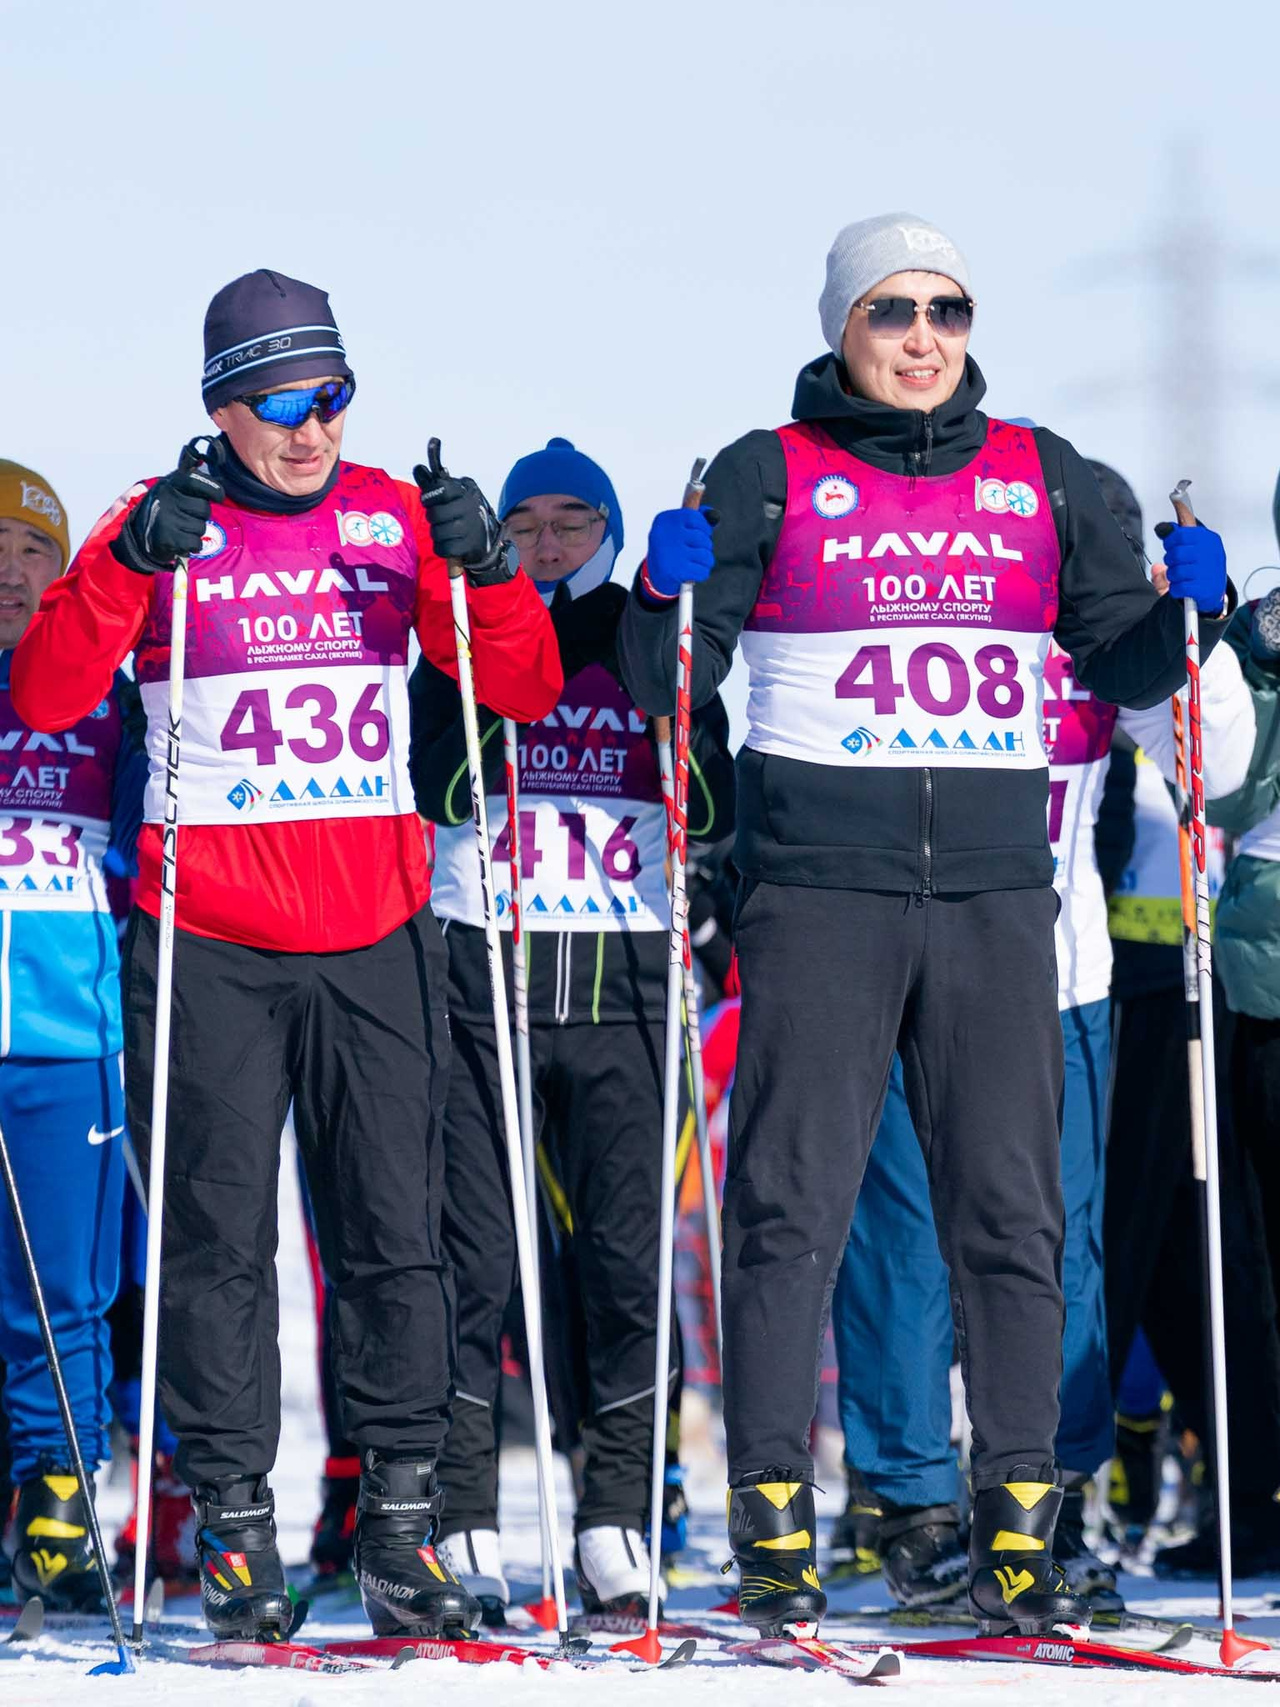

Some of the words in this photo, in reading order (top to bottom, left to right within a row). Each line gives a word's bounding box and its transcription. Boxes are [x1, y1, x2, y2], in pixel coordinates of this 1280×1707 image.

[822, 531, 1024, 563] HAVAL
[196, 568, 389, 602] HAVAL
[862, 574, 926, 602] 100
[938, 574, 996, 601] ЛЕТ
[870, 603, 940, 615] ЛЫЖНОМУ
[942, 602, 992, 614] СПОРТУ
[877, 613, 930, 622] РЕСПУБЛИКЕ
[930, 613, 955, 621] САХА
[956, 613, 992, 623] (ЯКУТИЯ)
[237, 615, 298, 643] 100
[309, 611, 363, 639] ЛЕТ
[247, 642, 312, 656] ЛЫЖНОМУ
[314, 640, 360, 652] СПОРТУ
[254, 654, 304, 664] РЕСПУБЛИКЕ
[304, 652, 328, 661] САХА
[834, 641, 1024, 720] 408
[220, 683, 389, 766] 436
[518, 745, 569, 771] 100
[578, 748, 628, 773] ЛЕТ
[12, 766, 70, 790] ЛЕТ
[162, 709, 182, 897] FISCHER
[491, 811, 642, 882] 416
[220, 1506, 271, 1520] SALOMON
[380, 1502, 431, 1512] SALOMON
[415, 1642, 456, 1660] ATOMIC
[1033, 1642, 1076, 1662] ATOMIC
